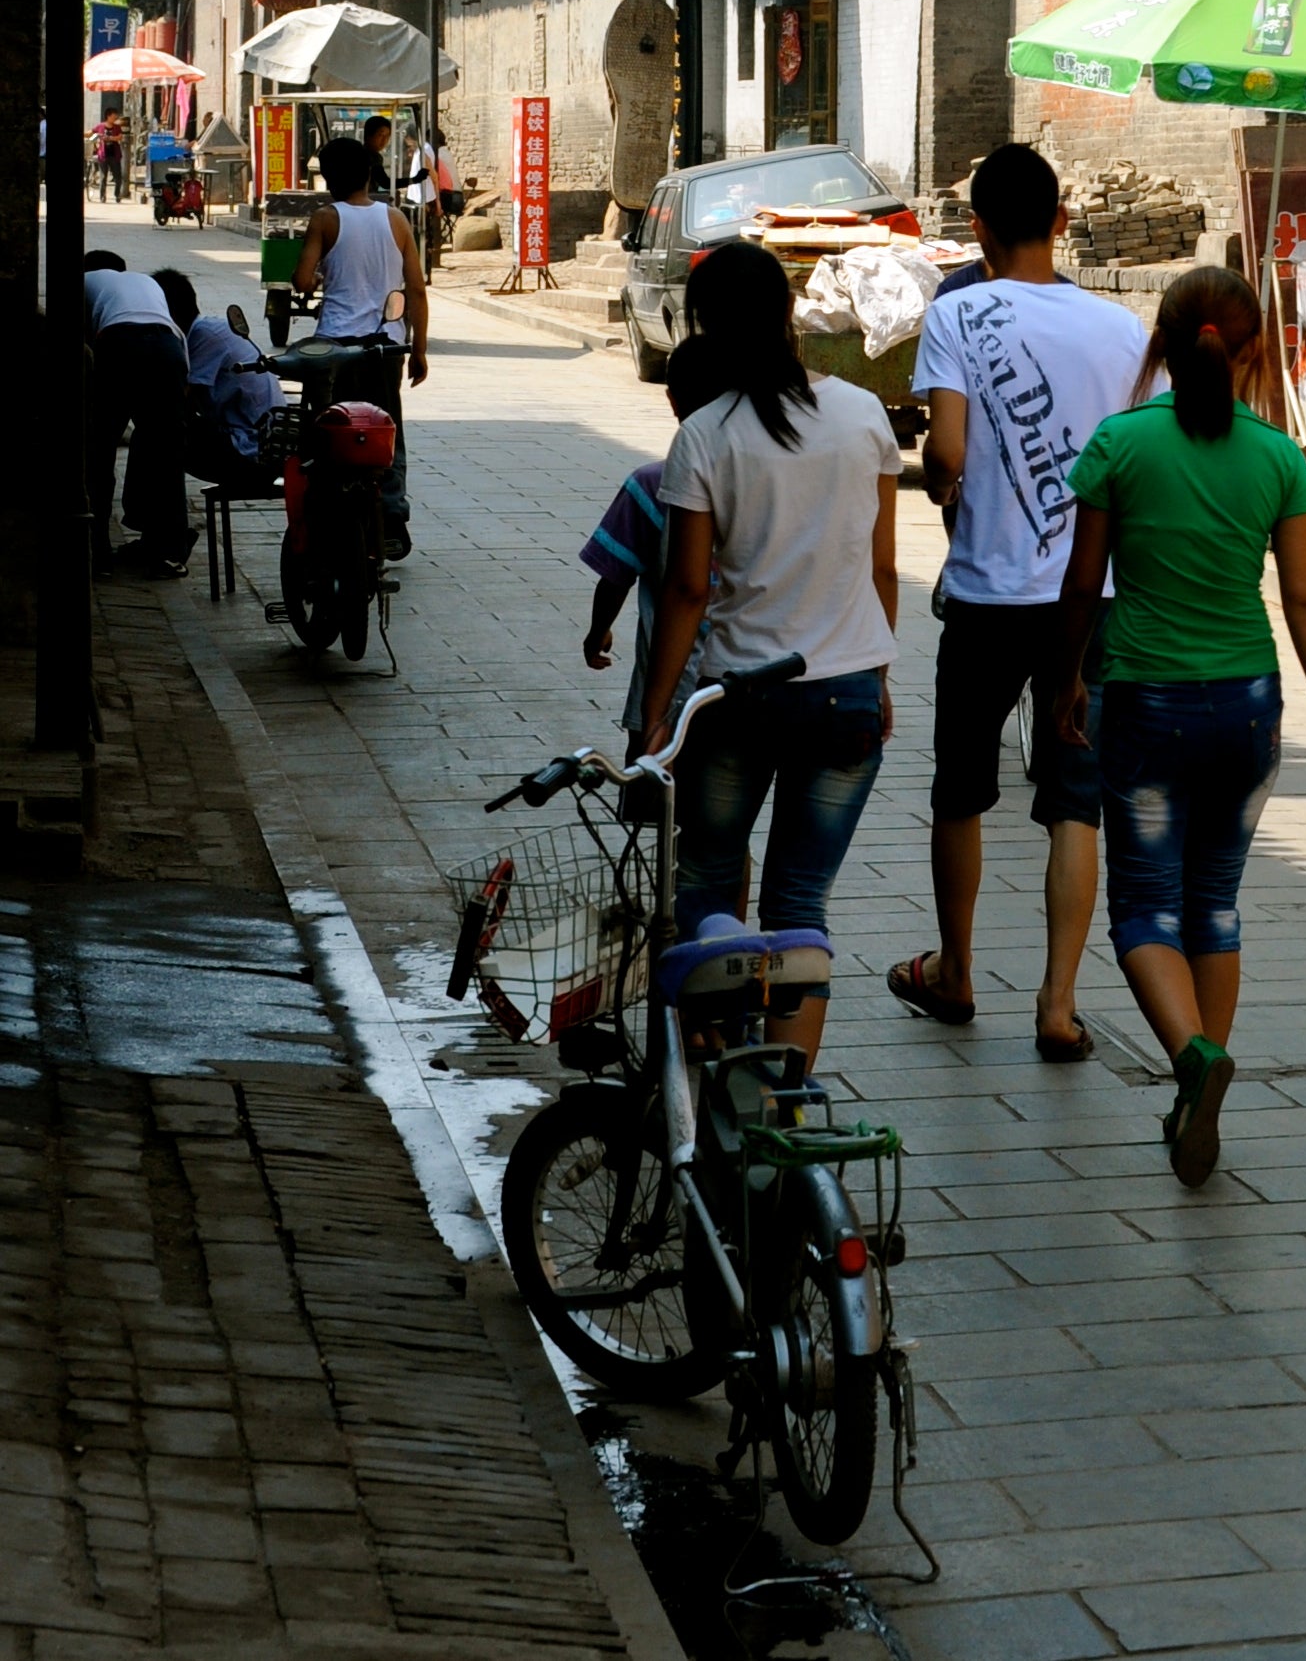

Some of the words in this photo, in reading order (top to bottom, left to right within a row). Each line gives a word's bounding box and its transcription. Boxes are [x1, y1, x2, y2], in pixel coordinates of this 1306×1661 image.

[526, 101, 545, 132] 餐饮
[525, 136, 545, 166] 住宿
[524, 170, 544, 200] 停车
[525, 204, 544, 263] 钟点休息
